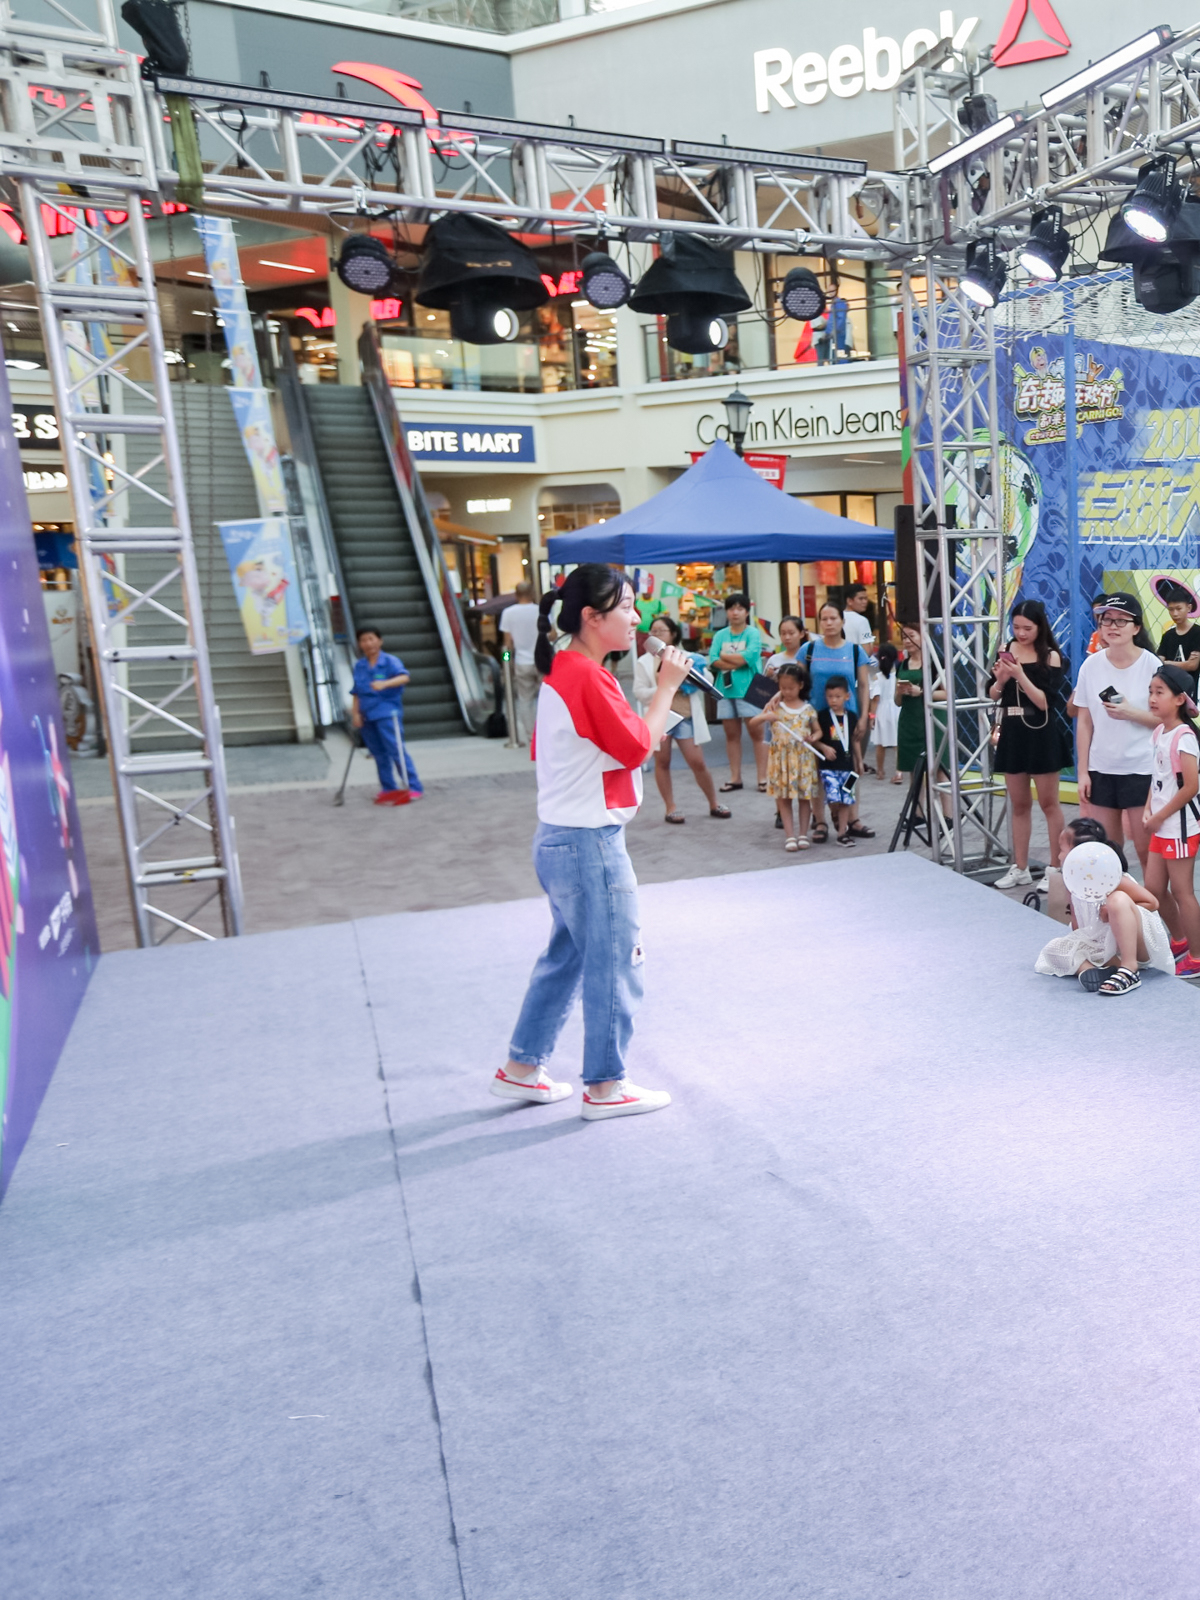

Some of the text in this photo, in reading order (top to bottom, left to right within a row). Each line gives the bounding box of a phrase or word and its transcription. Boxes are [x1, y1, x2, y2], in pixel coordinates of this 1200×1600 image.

[696, 402, 902, 446] Cain Klein Jeans
[407, 430, 523, 454] BITE MART
